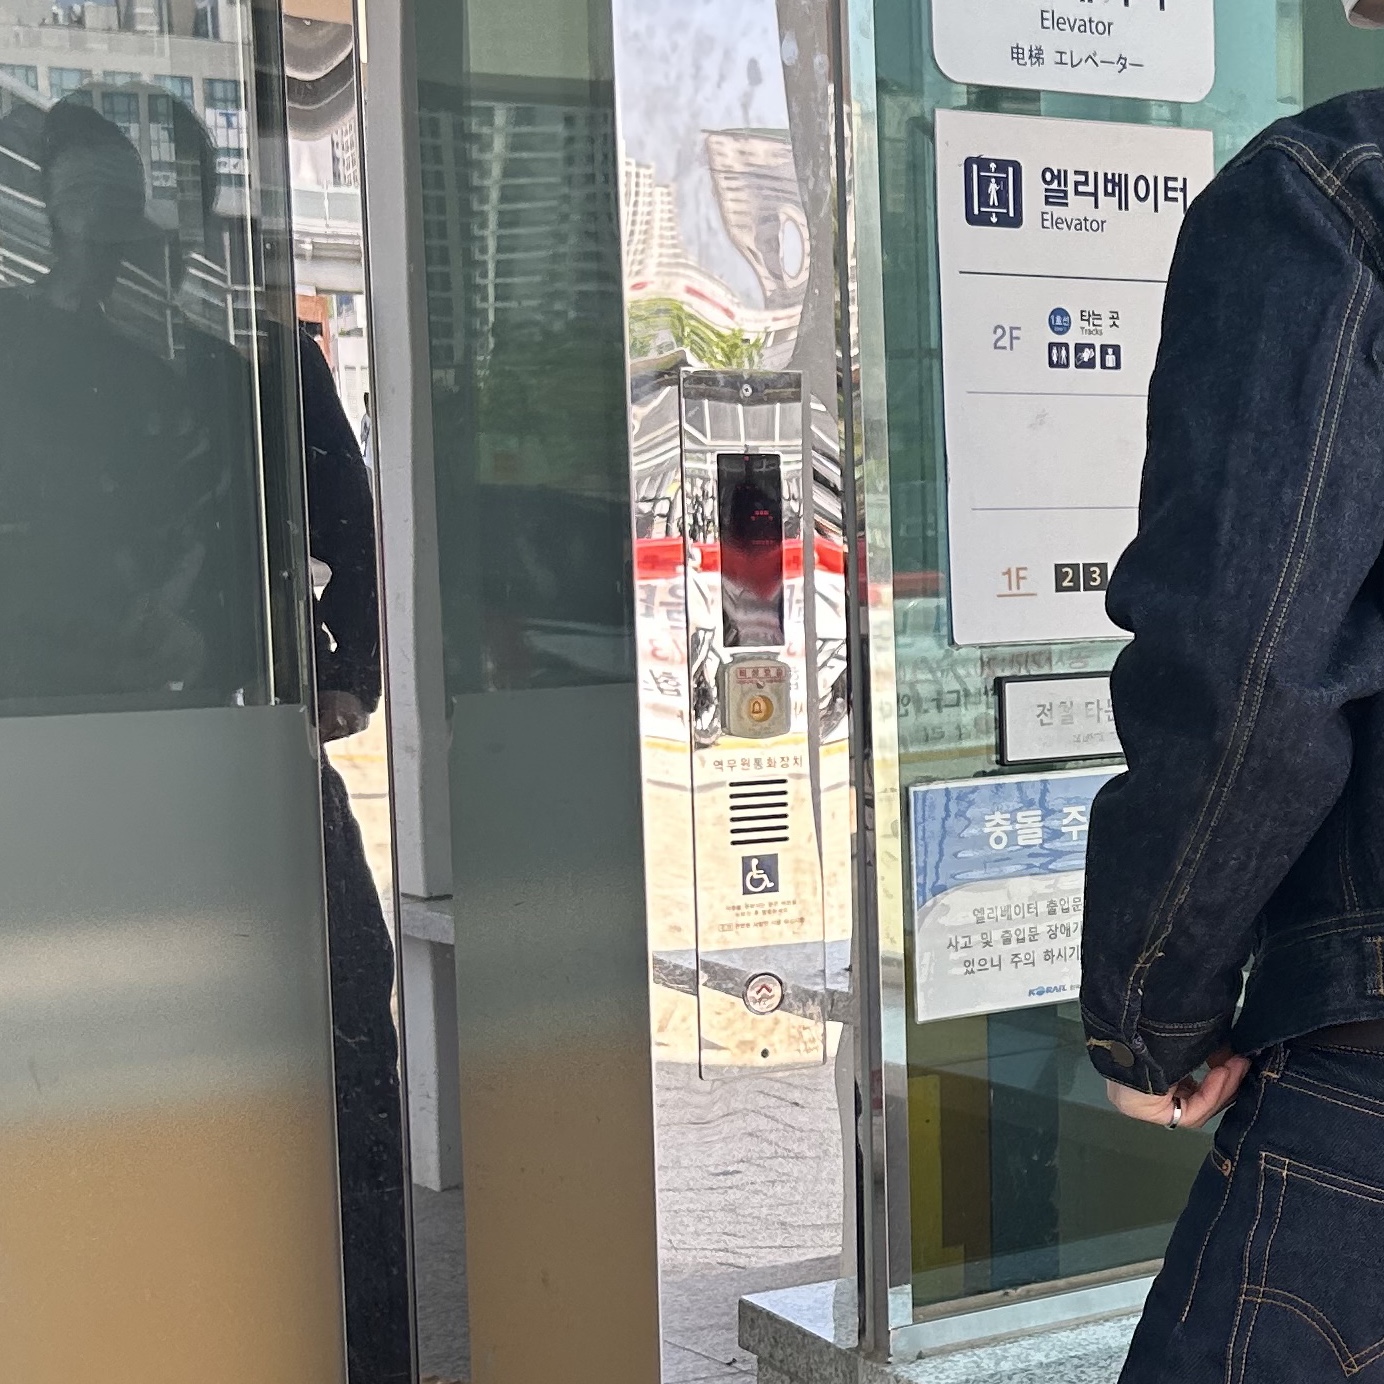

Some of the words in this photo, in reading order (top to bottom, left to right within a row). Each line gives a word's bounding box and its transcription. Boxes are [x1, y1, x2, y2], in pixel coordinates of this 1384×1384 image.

[1040, 9, 1114, 37] Elevator
[1010, 43, 1045, 68] 电梯
[1054, 50, 1145, 74] エレベーター
[1041, 166, 1188, 215] 엘리베이터
[1041, 211, 1107, 233] Elevator
[1080, 310, 1103, 328] 타는
[1108, 310, 1120, 329] 곳
[1080, 326, 1104, 337] Tracks
[993, 324, 1022, 352] 2F
[1001, 566, 1029, 592] 1F
[1061, 567, 1075, 588] 2
[1089, 565, 1102, 586] 3
[713, 755, 804, 773] 역무원통화장치
[983, 808, 1044, 851] 충돌
[972, 900, 1039, 925] 엘리베이터
[1046, 896, 1083, 916] 출입문
[946, 934, 974, 953] 사고
[980, 930, 994, 949] 및
[1001, 925, 1040, 946] 출입문
[963, 954, 1002, 976] 있으니
[1010, 949, 1036, 970] 주의
[1042, 944, 1080, 965] 하시기
